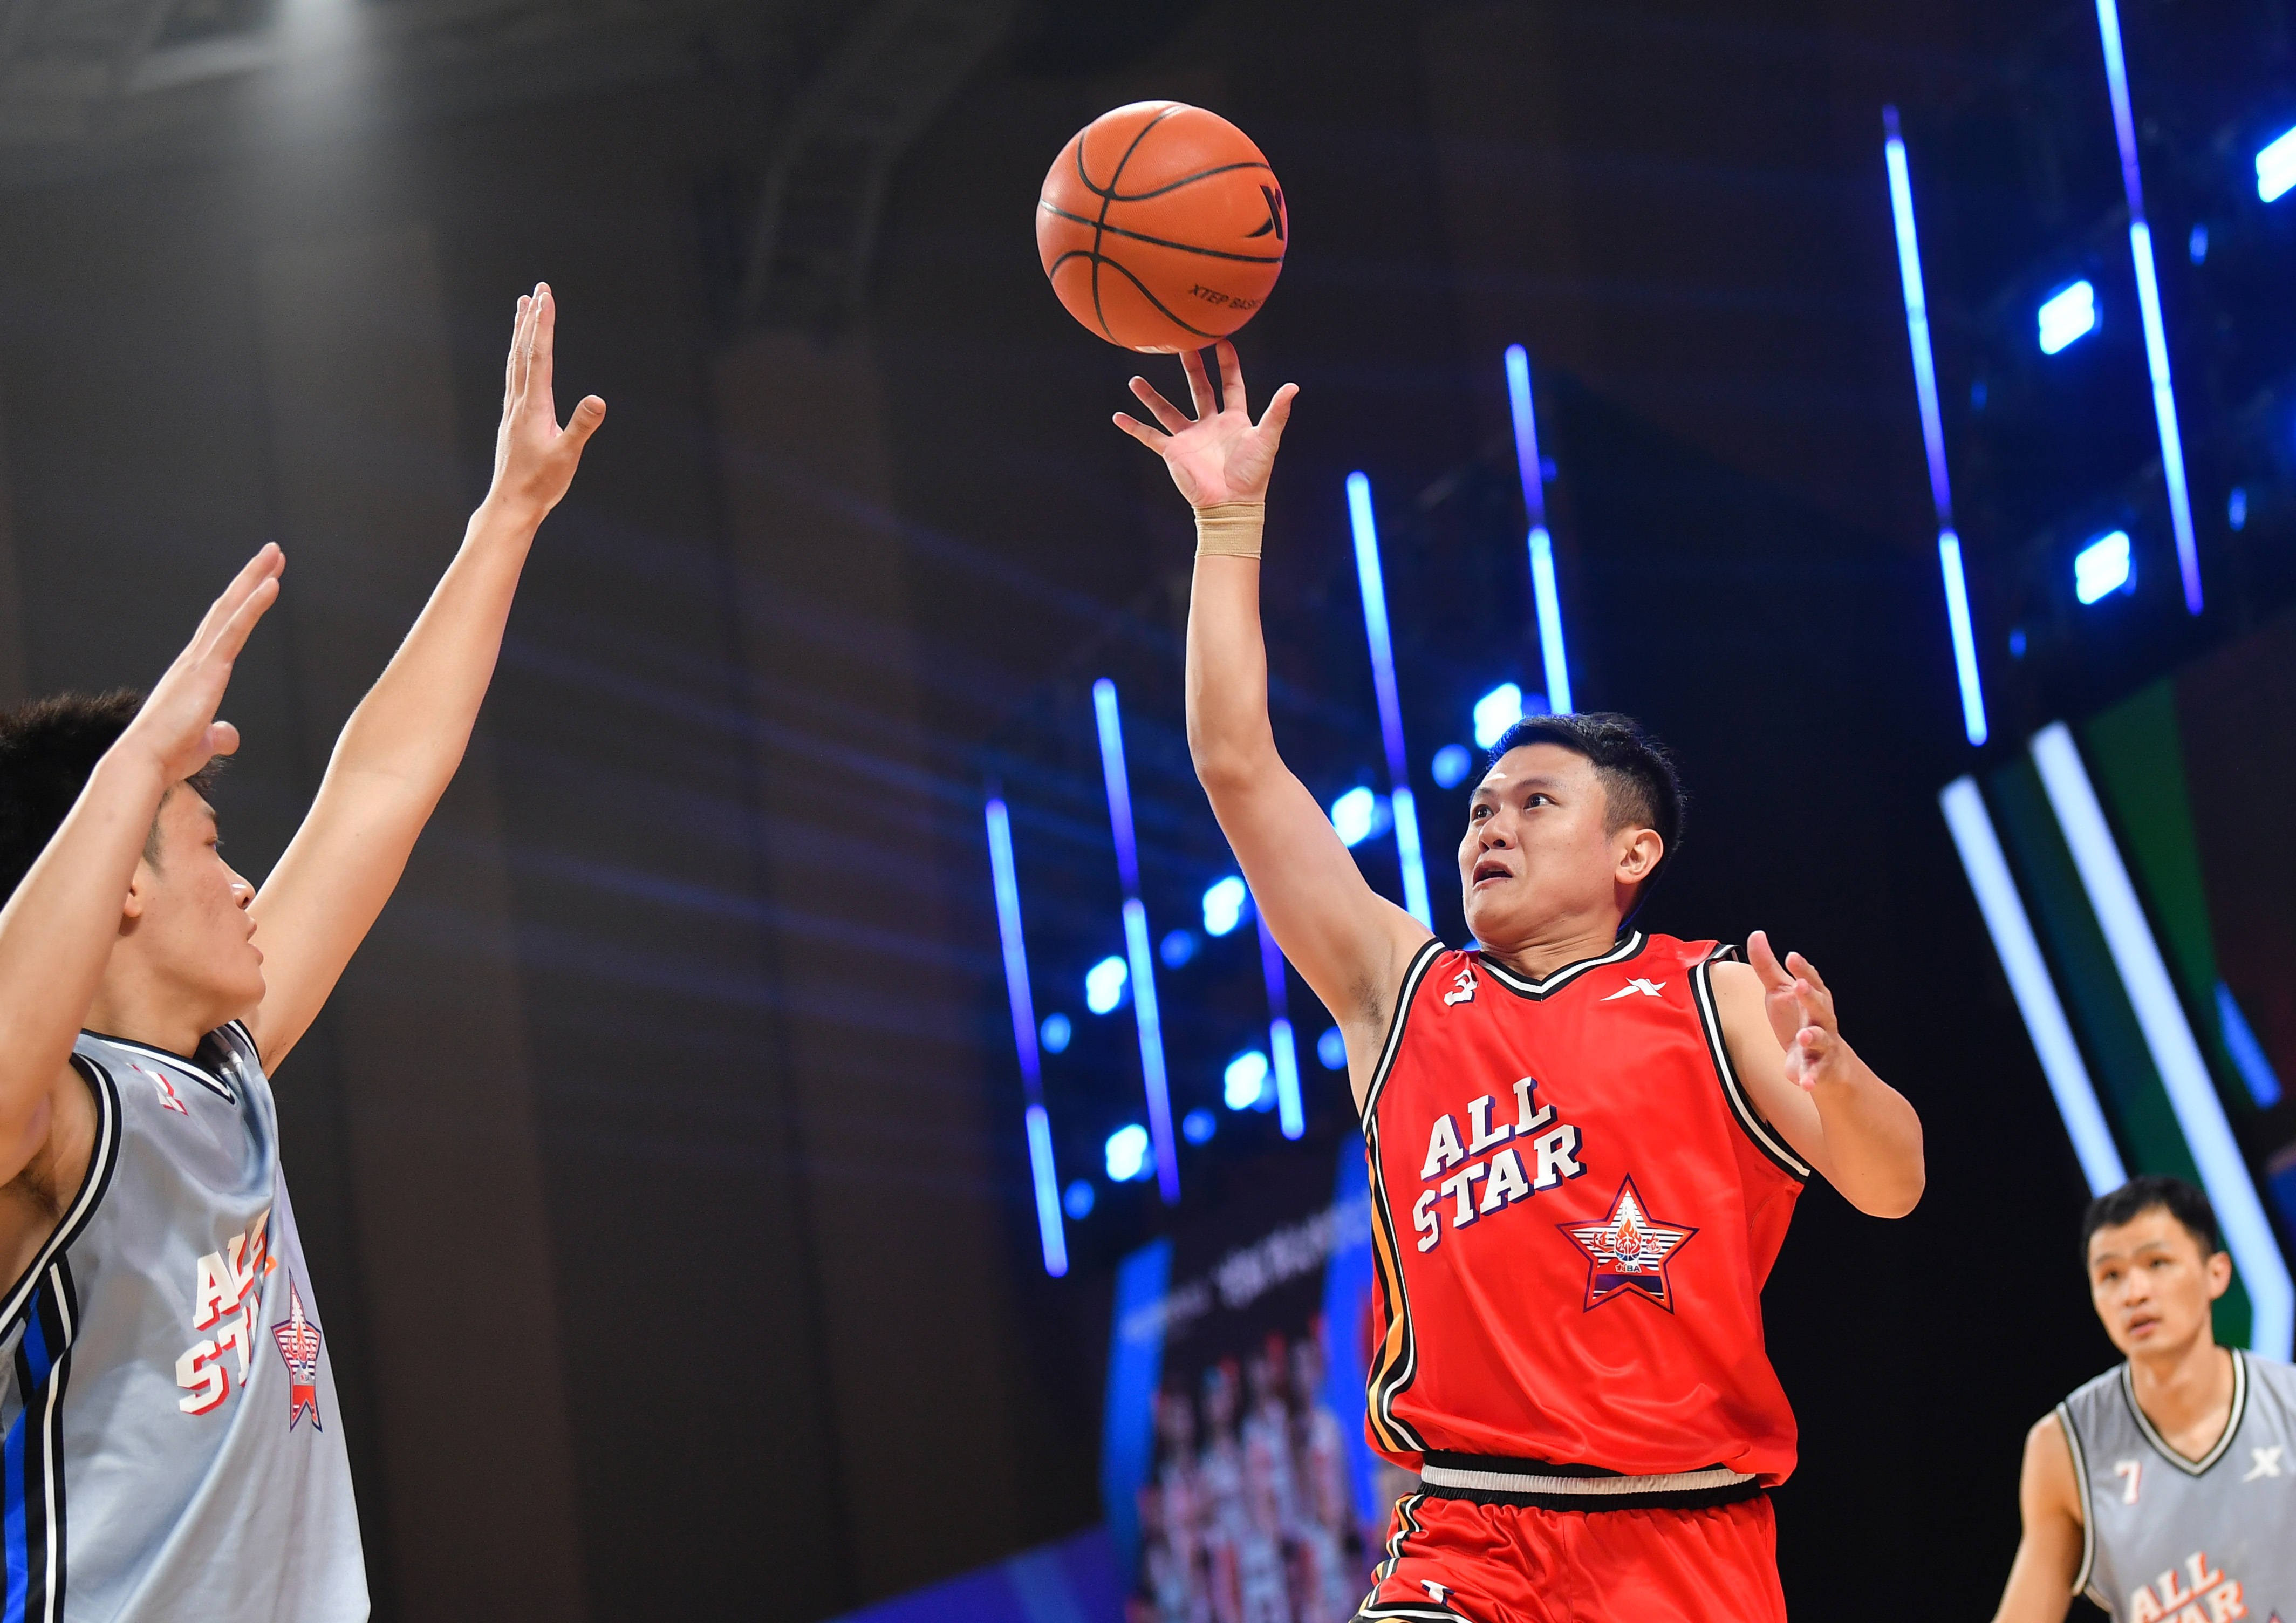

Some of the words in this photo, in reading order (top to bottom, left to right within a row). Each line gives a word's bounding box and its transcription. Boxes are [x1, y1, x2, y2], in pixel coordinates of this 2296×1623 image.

[1188, 283, 1229, 304] XTEP
[1229, 297, 1262, 311] BAS
[1444, 969, 1479, 1007] 3
[1420, 1076, 1558, 1182] ALL
[1412, 1124, 1587, 1254] STAR
[175, 1255, 278, 1416] ST
[2114, 1460, 2142, 1505] 7
[2129, 1551, 2226, 1623] ALL
